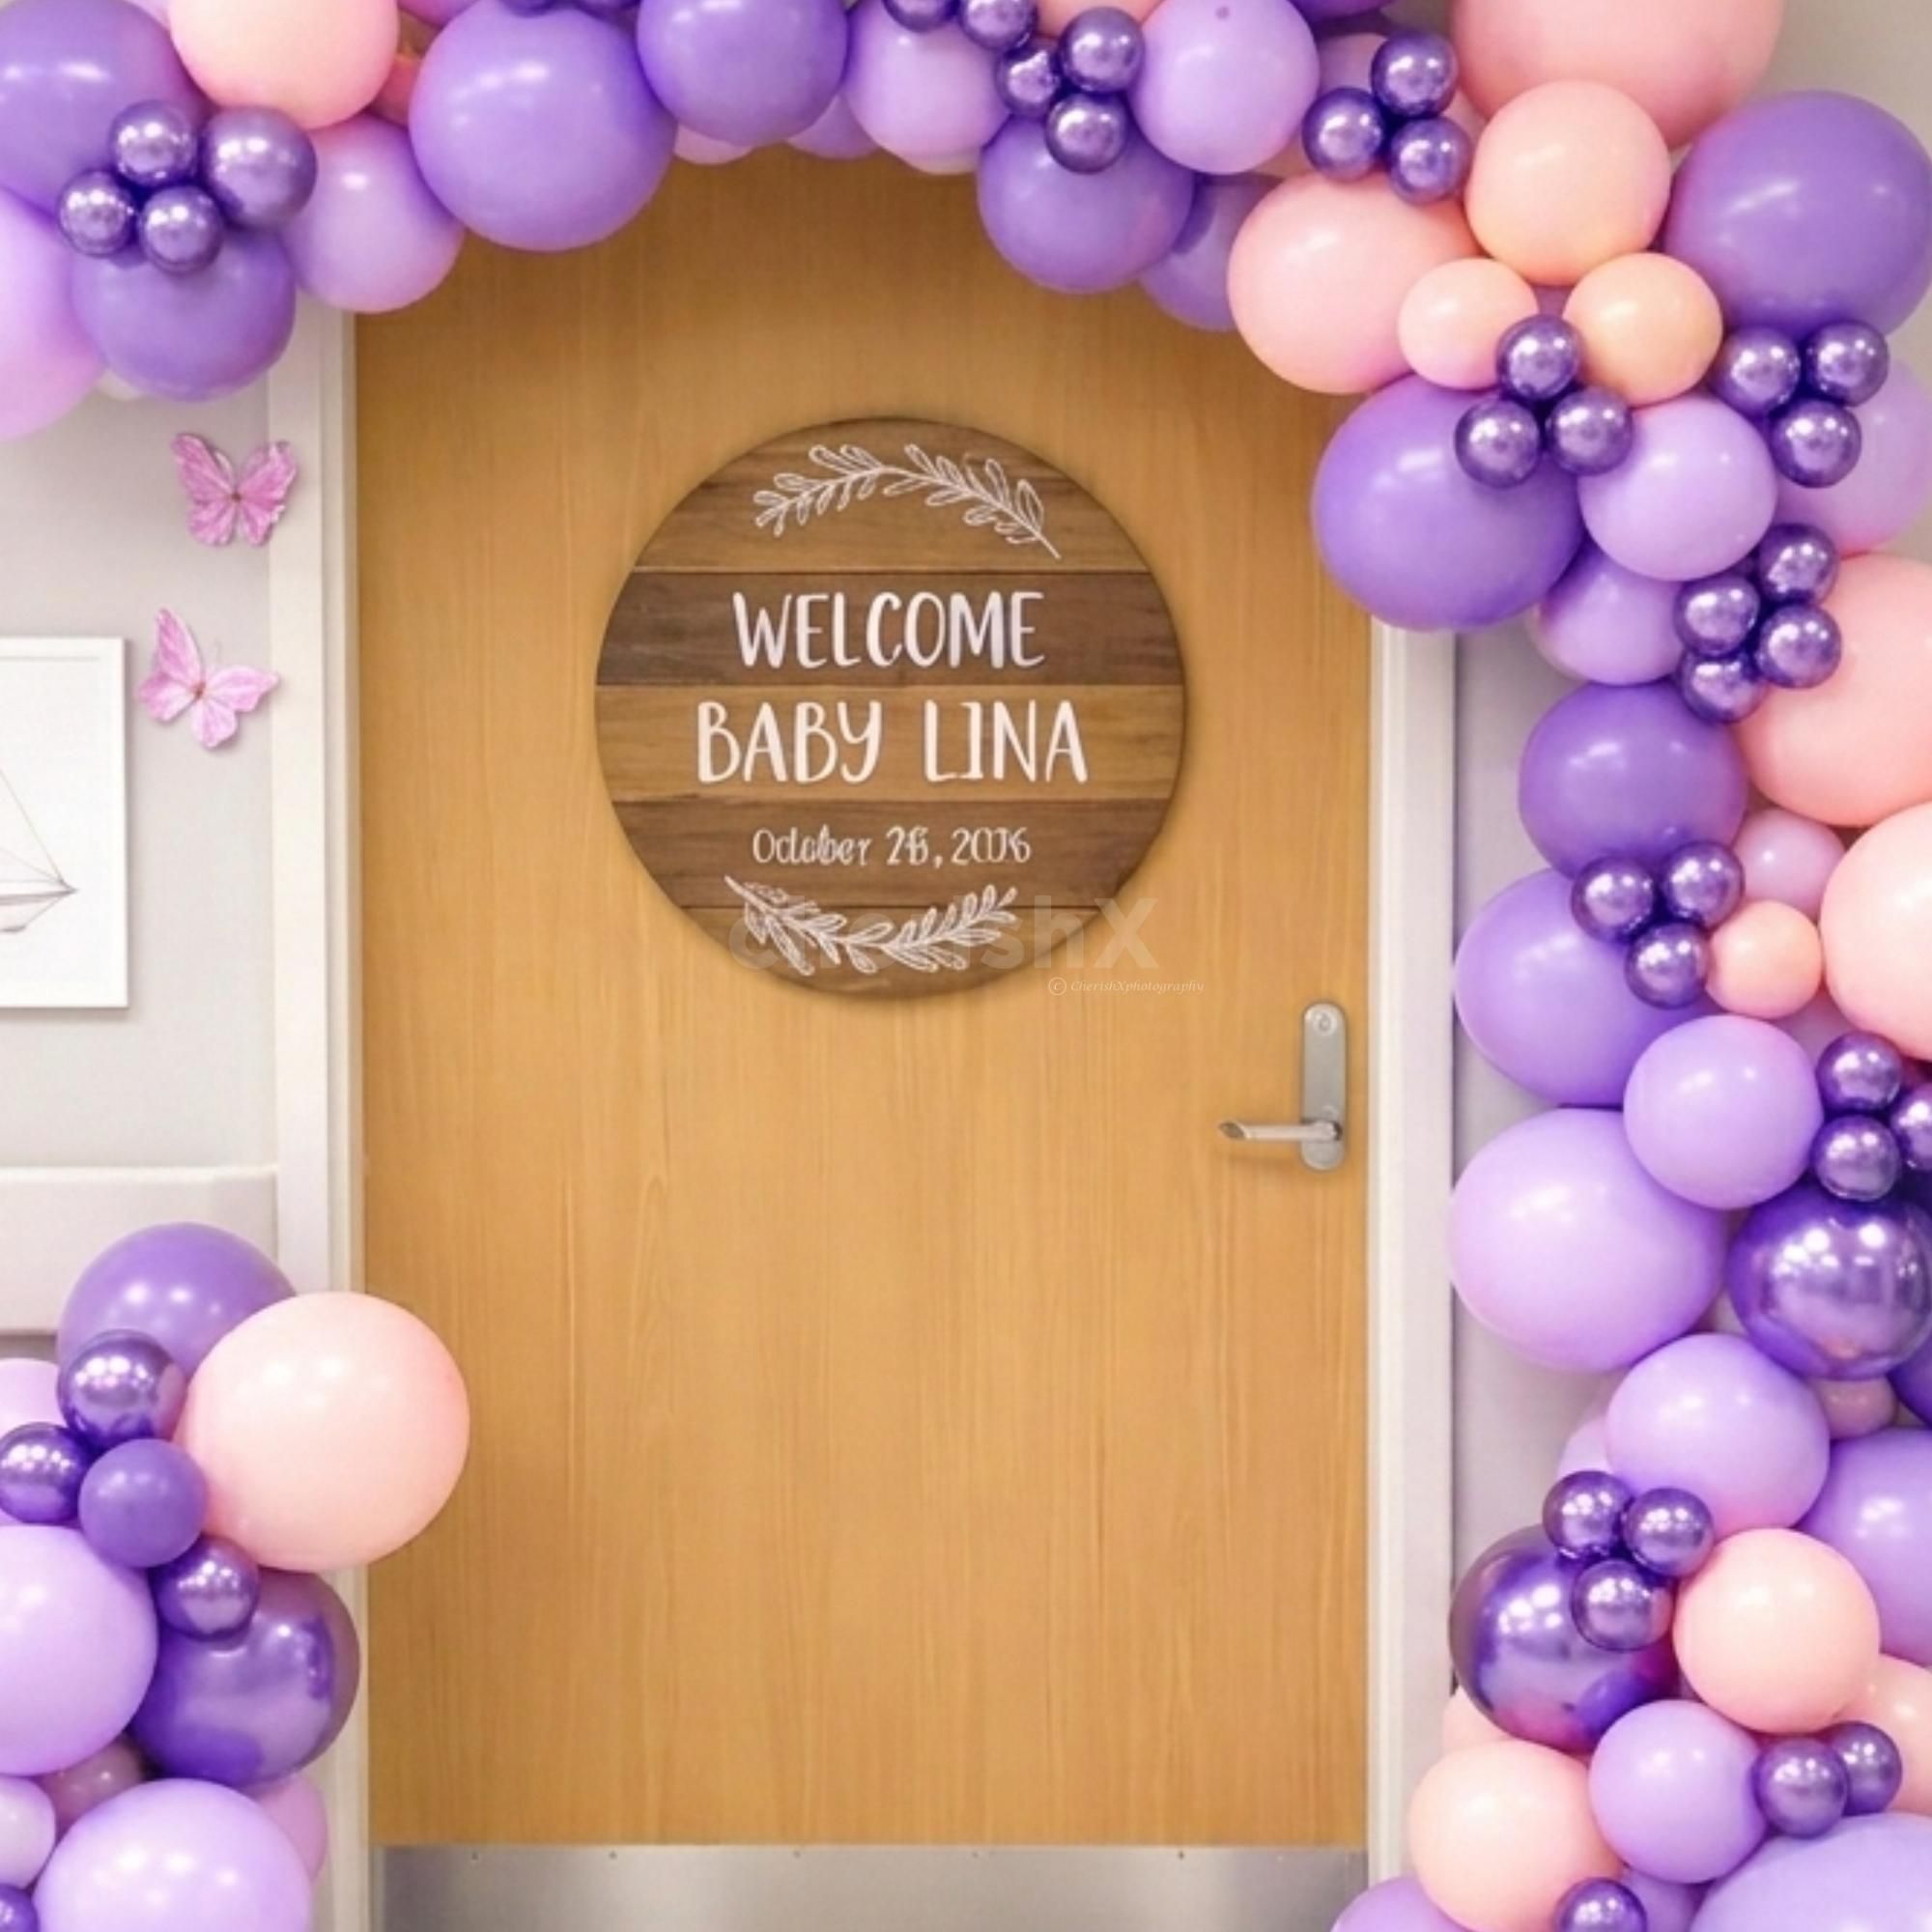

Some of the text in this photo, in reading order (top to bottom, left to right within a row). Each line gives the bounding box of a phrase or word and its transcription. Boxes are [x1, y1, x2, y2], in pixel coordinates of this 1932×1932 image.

[732, 590, 1045, 668] WELCOME
[697, 699, 1089, 783] BABY LINA
